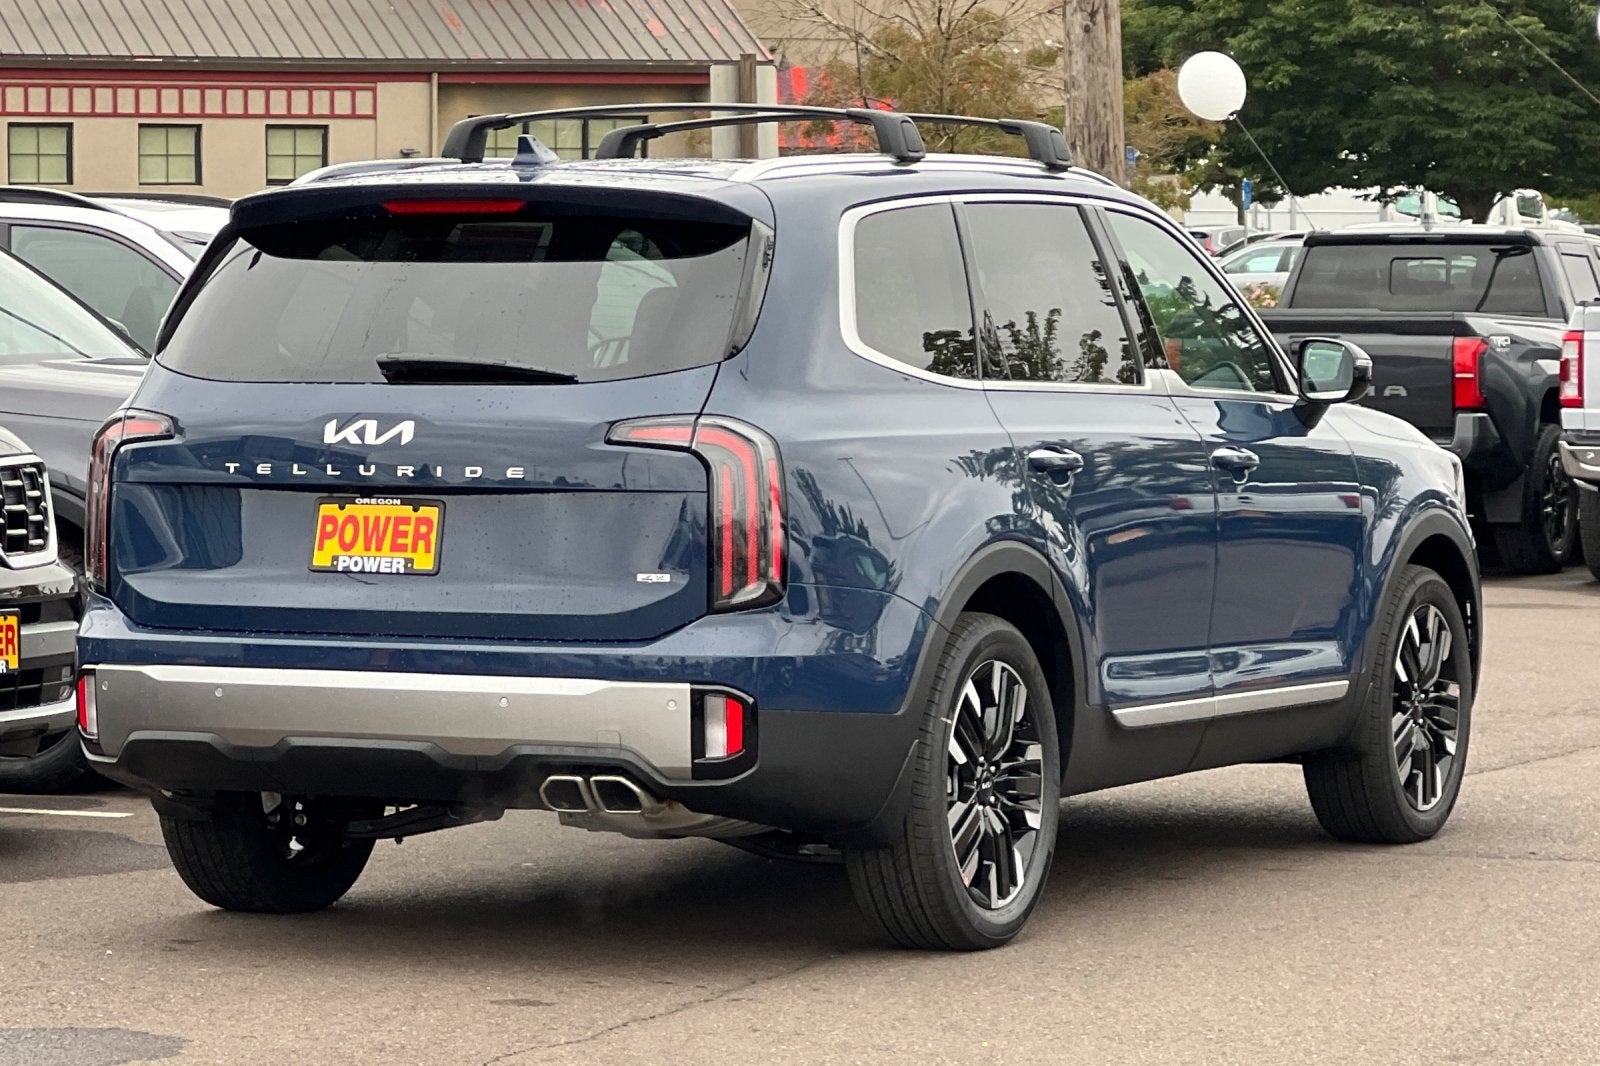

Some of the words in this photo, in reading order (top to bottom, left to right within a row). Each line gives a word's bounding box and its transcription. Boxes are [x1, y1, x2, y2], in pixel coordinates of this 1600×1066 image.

[323, 419, 415, 446] KIA
[225, 462, 525, 478] TELLURIDE
[355, 497, 401, 505] OREGON
[317, 514, 434, 553] POWER
[337, 555, 405, 573] POWER
